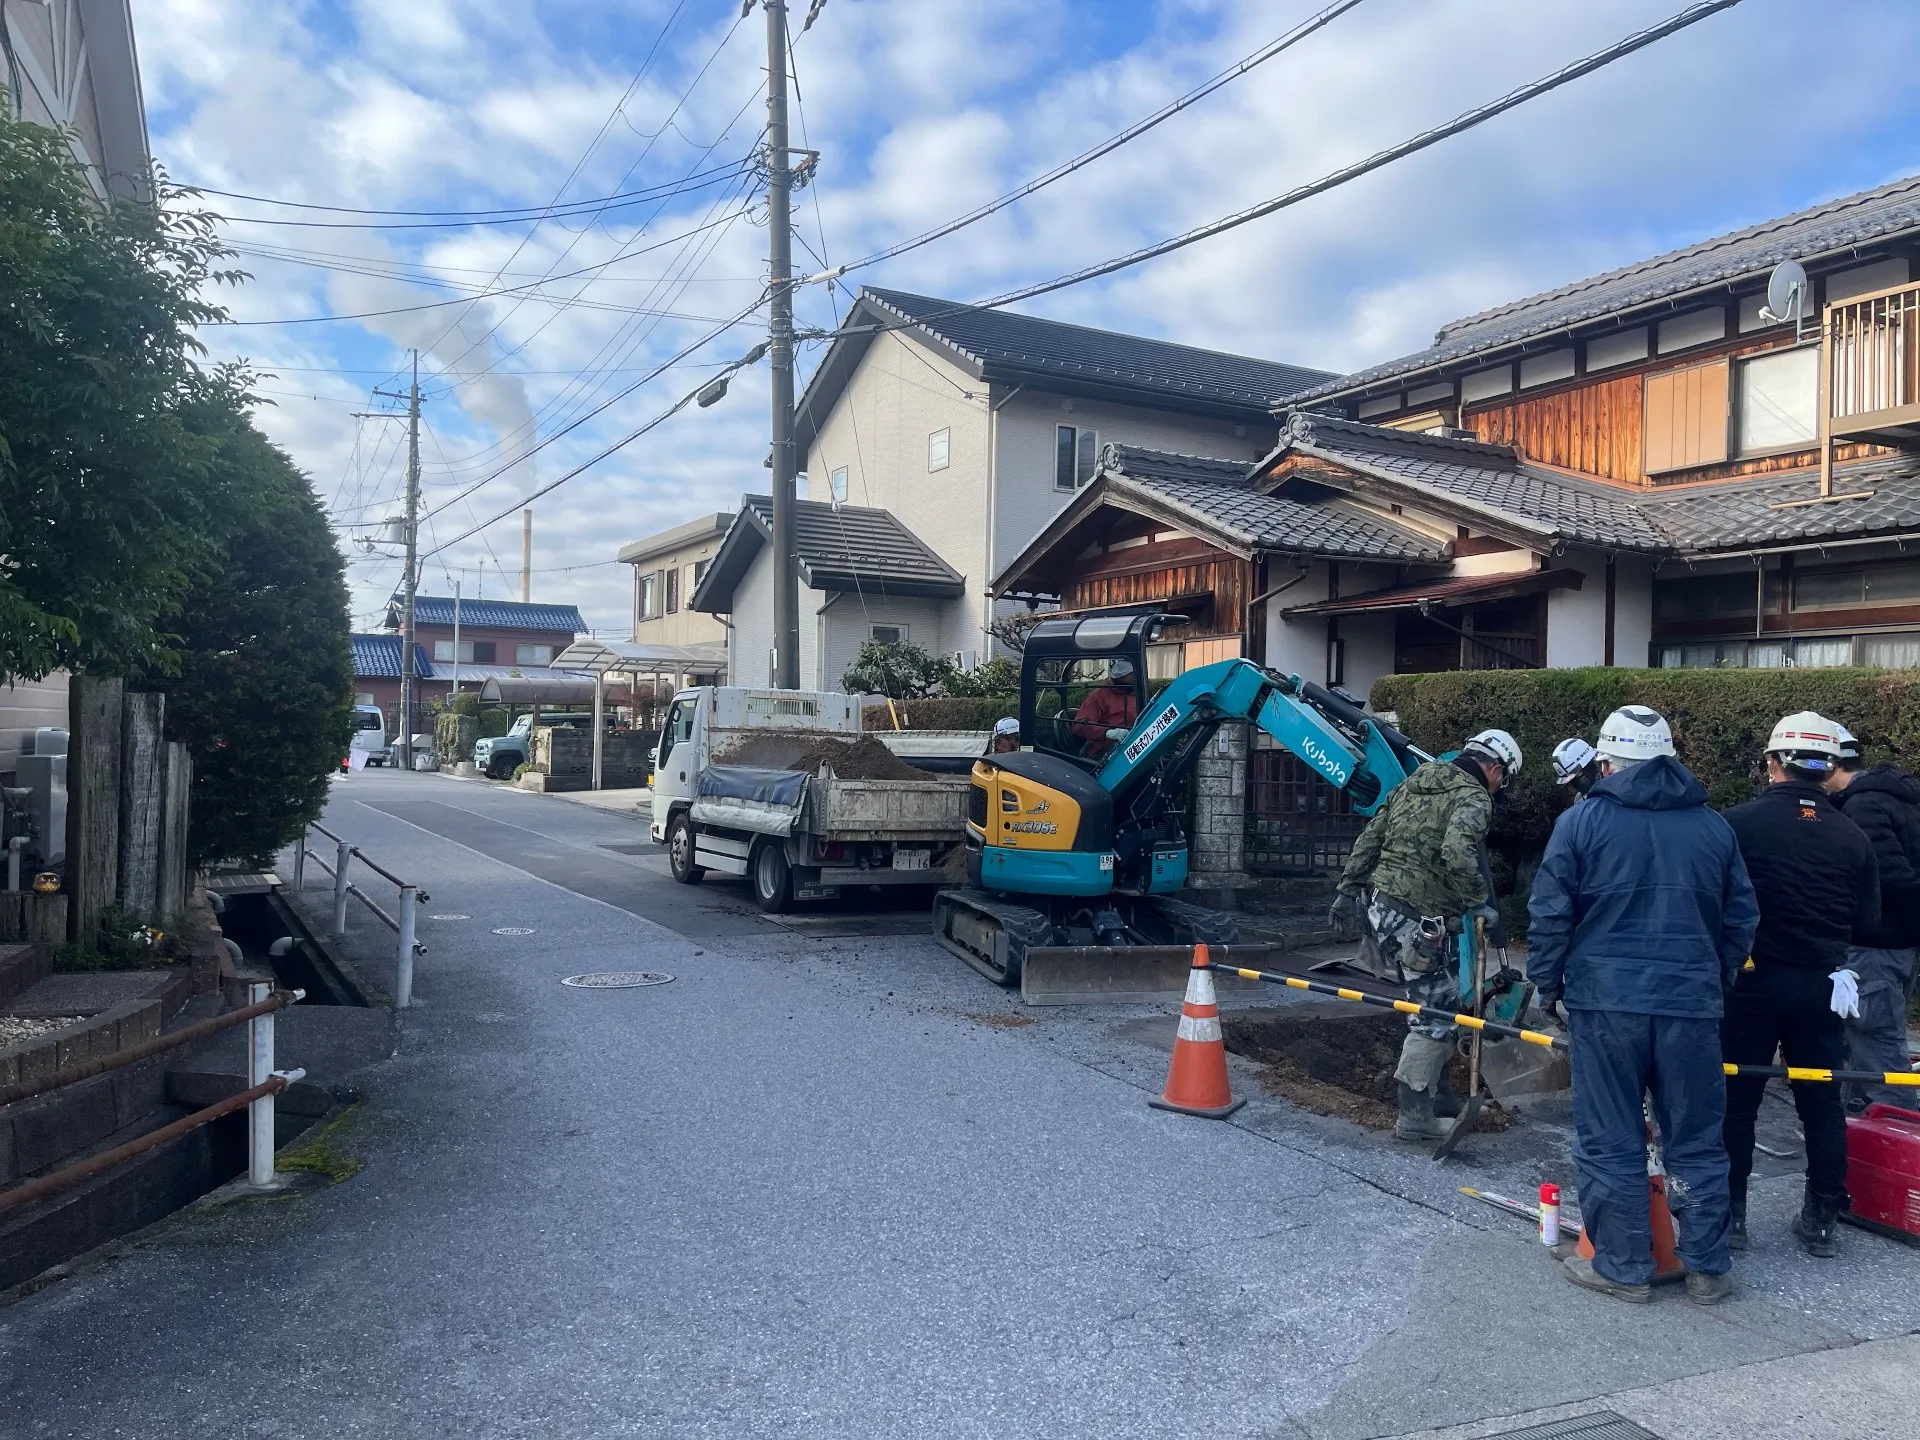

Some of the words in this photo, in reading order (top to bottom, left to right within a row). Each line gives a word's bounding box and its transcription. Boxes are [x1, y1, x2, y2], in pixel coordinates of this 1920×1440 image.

[1126, 706, 1179, 761] 移動式クレーン仕様機
[1302, 736, 1346, 783] Kubota
[1011, 820, 1059, 835] RX306E
[798, 888, 836, 898] ELF
